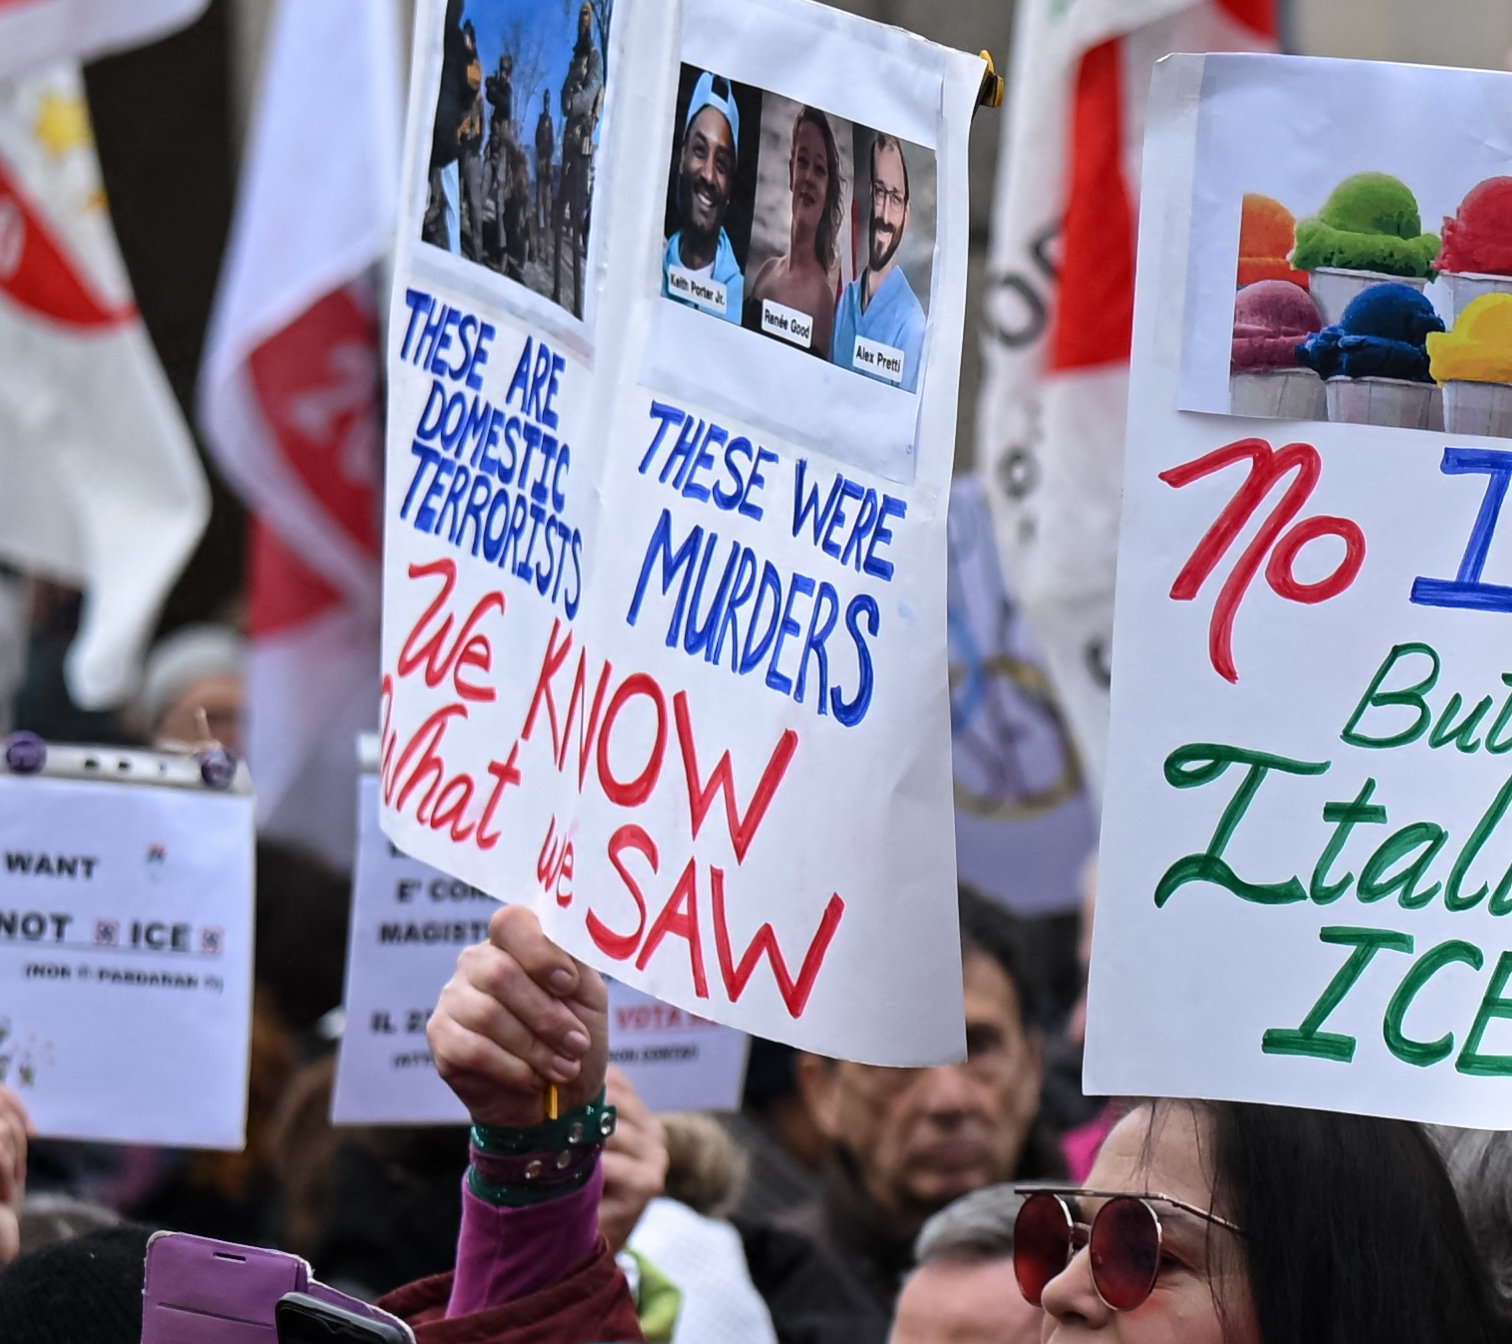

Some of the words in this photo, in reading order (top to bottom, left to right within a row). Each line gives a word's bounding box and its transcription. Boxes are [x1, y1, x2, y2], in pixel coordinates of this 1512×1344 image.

[403, 288, 496, 393] THESE
[506, 334, 567, 432] ARE
[690, 279, 714, 302] Porter
[714, 291, 726, 306] Jr.
[764, 308, 788, 329] Renée
[789, 318, 811, 341] Good
[855, 345, 875, 365] Alex
[876, 351, 902, 374] Pretti
[415, 378, 574, 514] DOMESTIC
[636, 400, 779, 522] THESE
[793, 458, 908, 582] WERE
[399, 440, 583, 621] TERRORISTS
[626, 507, 881, 730] MURDERS
[397, 557, 508, 703] We
[520, 618, 800, 866] KNOW
[3, 849, 99, 880] WANT
[380, 673, 523, 852] What
[536, 815, 576, 910] we
[584, 824, 845, 1020] SAW
[130, 924, 194, 951] ICE
